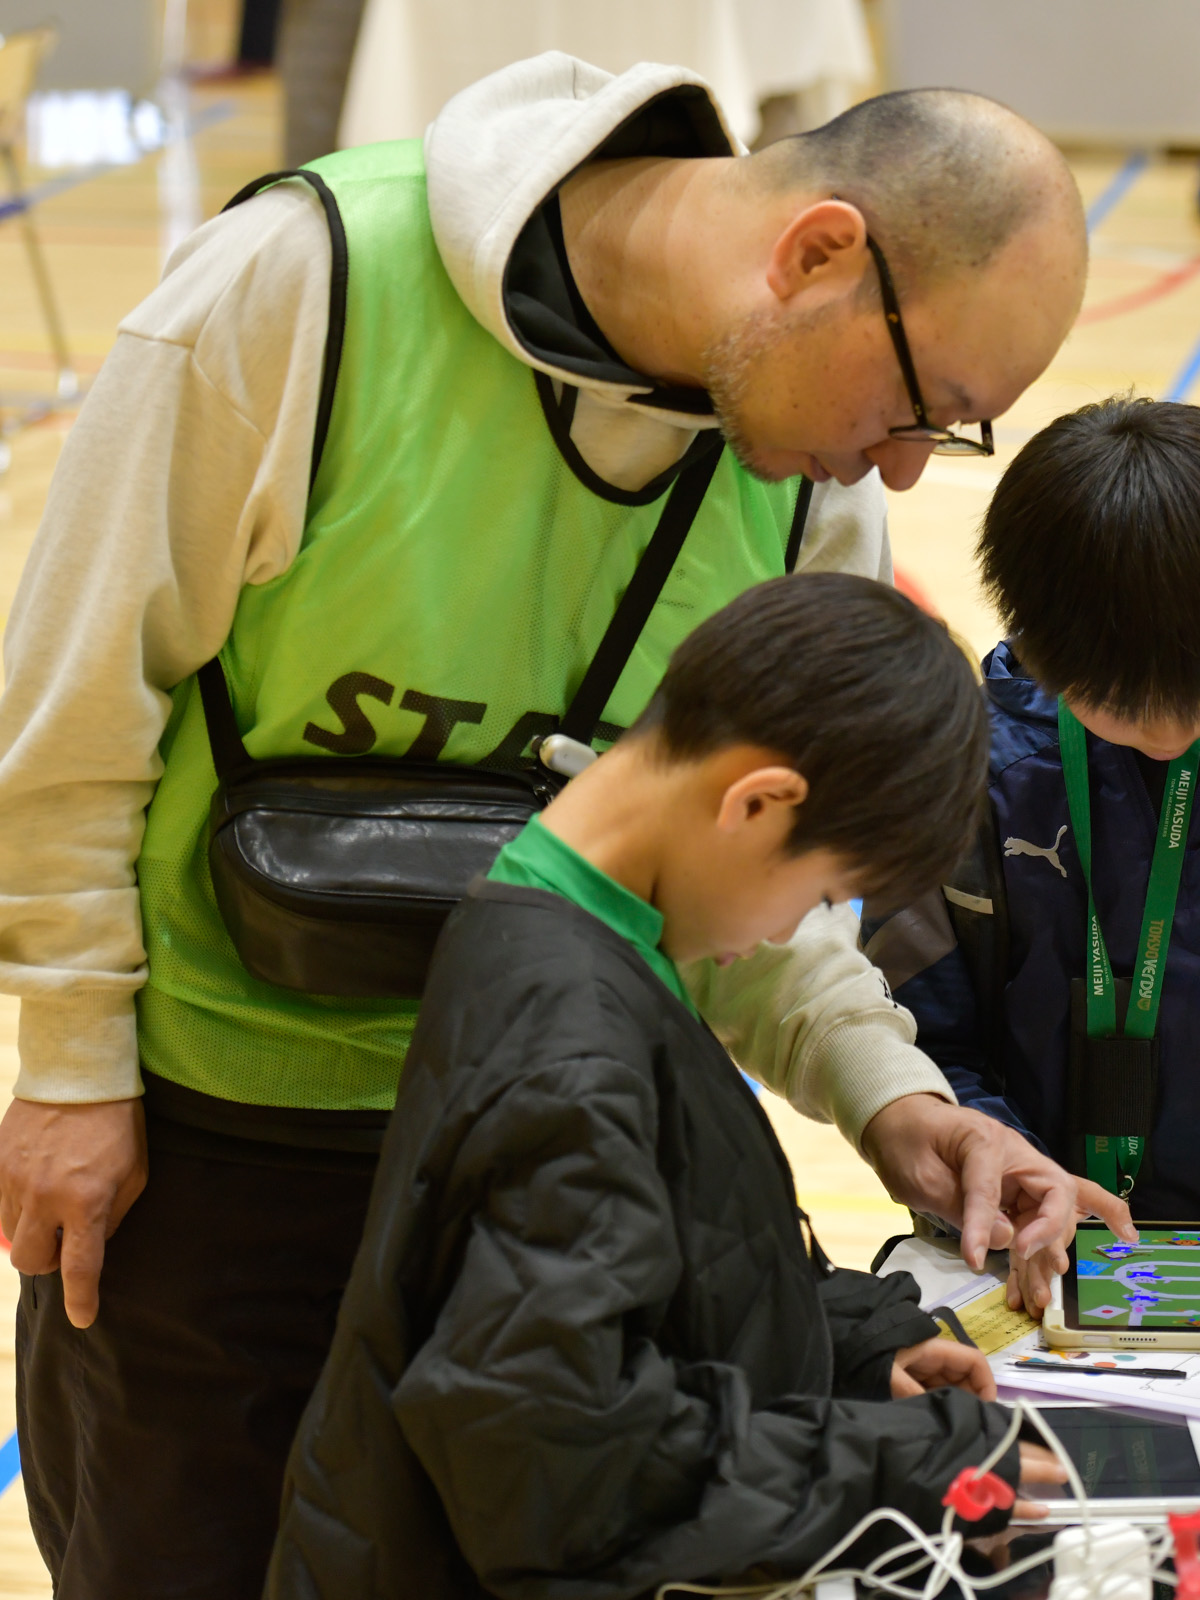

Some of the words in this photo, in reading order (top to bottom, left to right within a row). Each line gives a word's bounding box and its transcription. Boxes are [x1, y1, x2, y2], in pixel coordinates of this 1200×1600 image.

[1177, 769, 1191, 800] MEIJI
[1162, 796, 1173, 838] HEADQUARTERS
[1168, 802, 1186, 848] YASUDA
[1091, 915, 1101, 963] YASUDA
[1093, 965, 1104, 996] MEIJI
